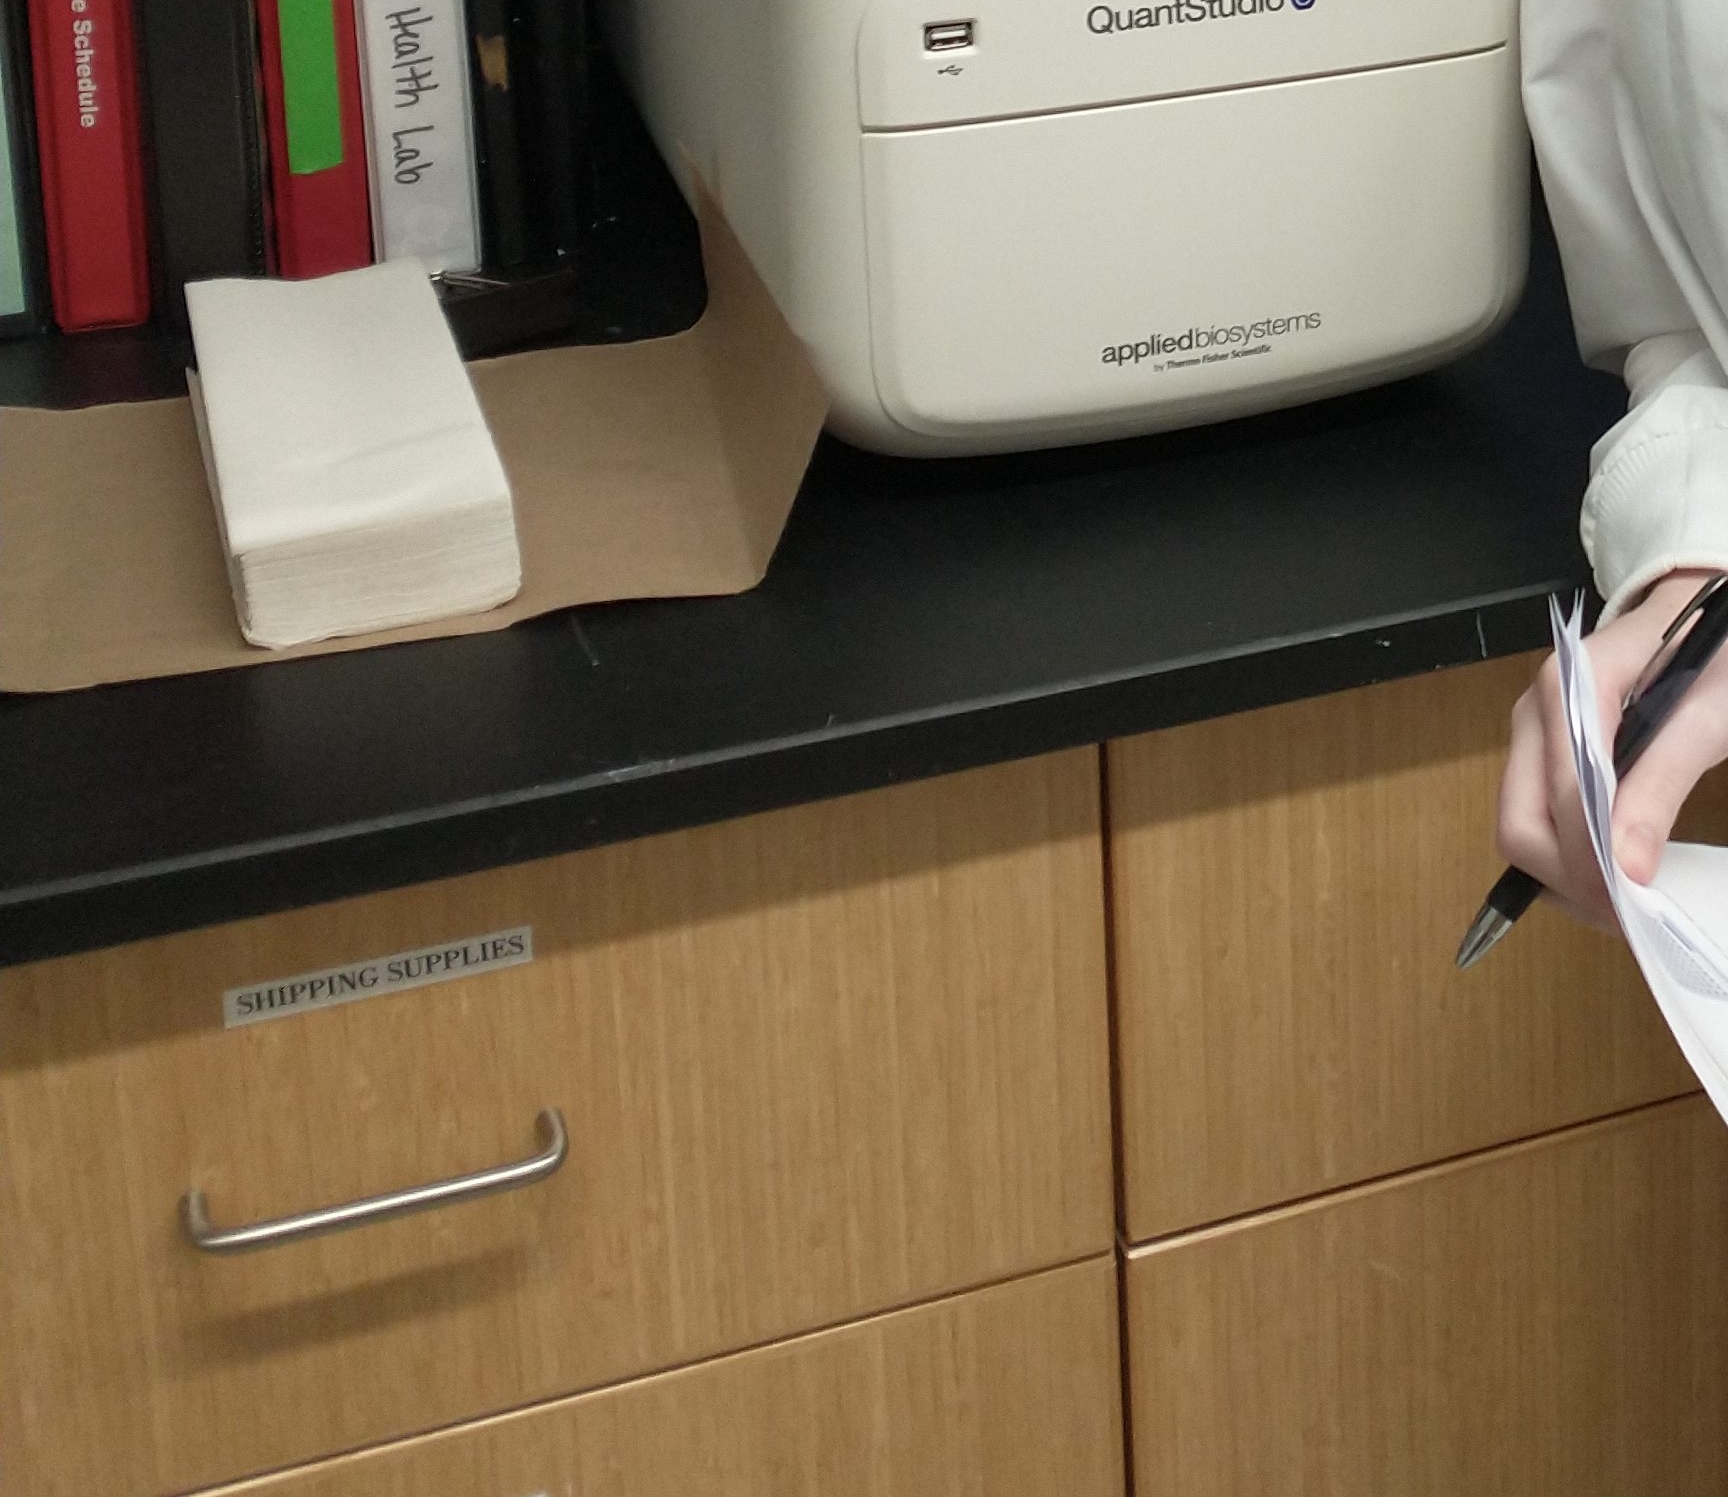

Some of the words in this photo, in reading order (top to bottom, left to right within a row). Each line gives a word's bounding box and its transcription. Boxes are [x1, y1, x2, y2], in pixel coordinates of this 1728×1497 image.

[72, 19, 99, 129] Schedule
[384, 6, 440, 109] Health
[391, 124, 435, 185] Lab
[237, 965, 379, 1016] SHIPPING
[387, 934, 526, 983] SUPPLIES
